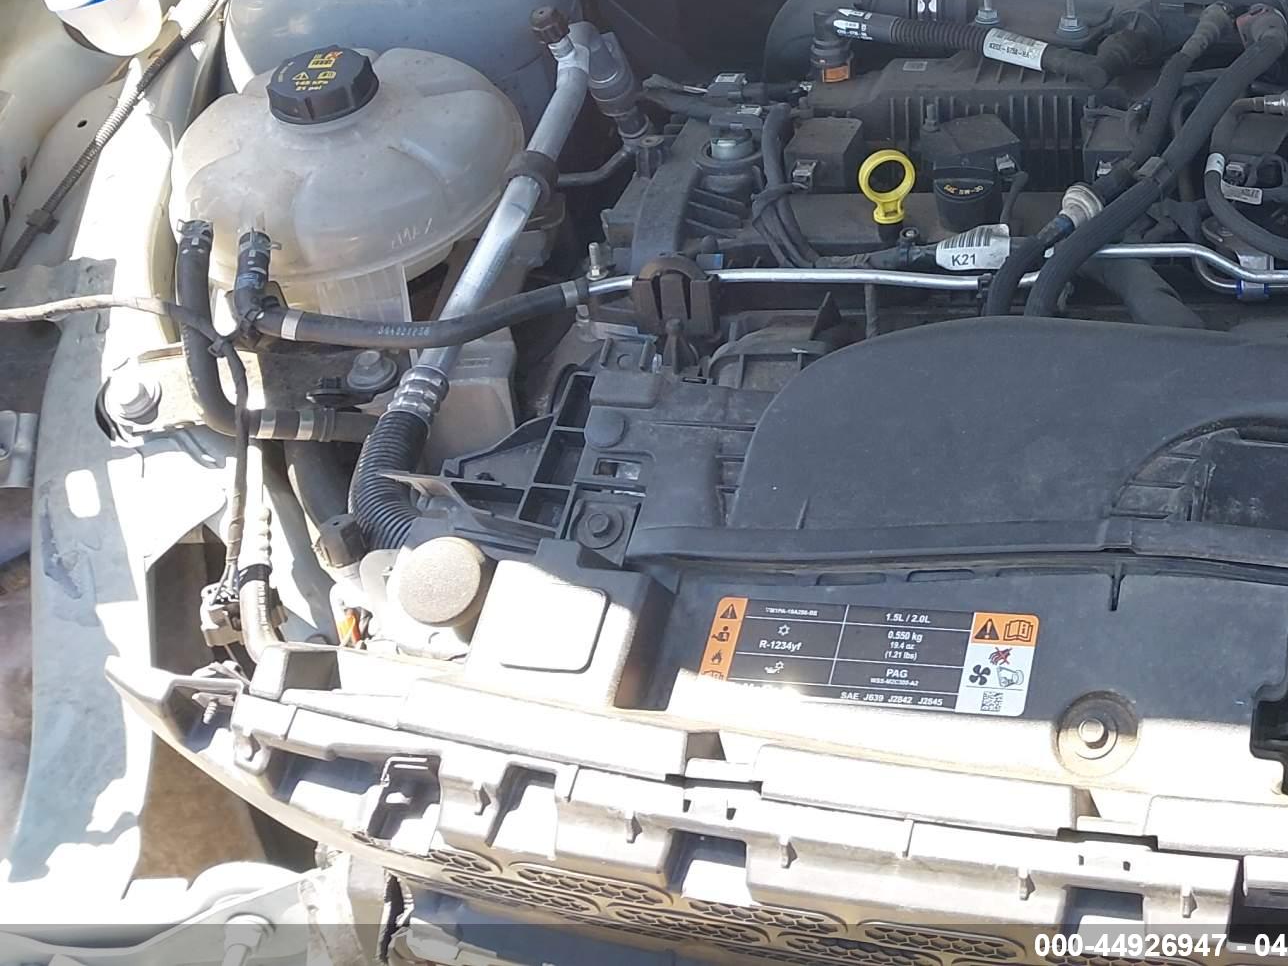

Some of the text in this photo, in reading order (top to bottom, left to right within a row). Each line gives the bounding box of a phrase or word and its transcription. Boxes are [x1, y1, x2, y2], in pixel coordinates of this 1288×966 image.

[951, 253, 976, 267] K21
[886, 613, 904, 622] 1.5L
[911, 614, 931, 624] 2.0L
[887, 630, 923, 643] 0.550 kg
[759, 639, 802, 652] R-1234yf
[890, 641, 905, 649] 19.4
[884, 650, 918, 661] (1.21 lbs)
[886, 668, 908, 678] PAG
[840, 691, 859, 700] SAE
